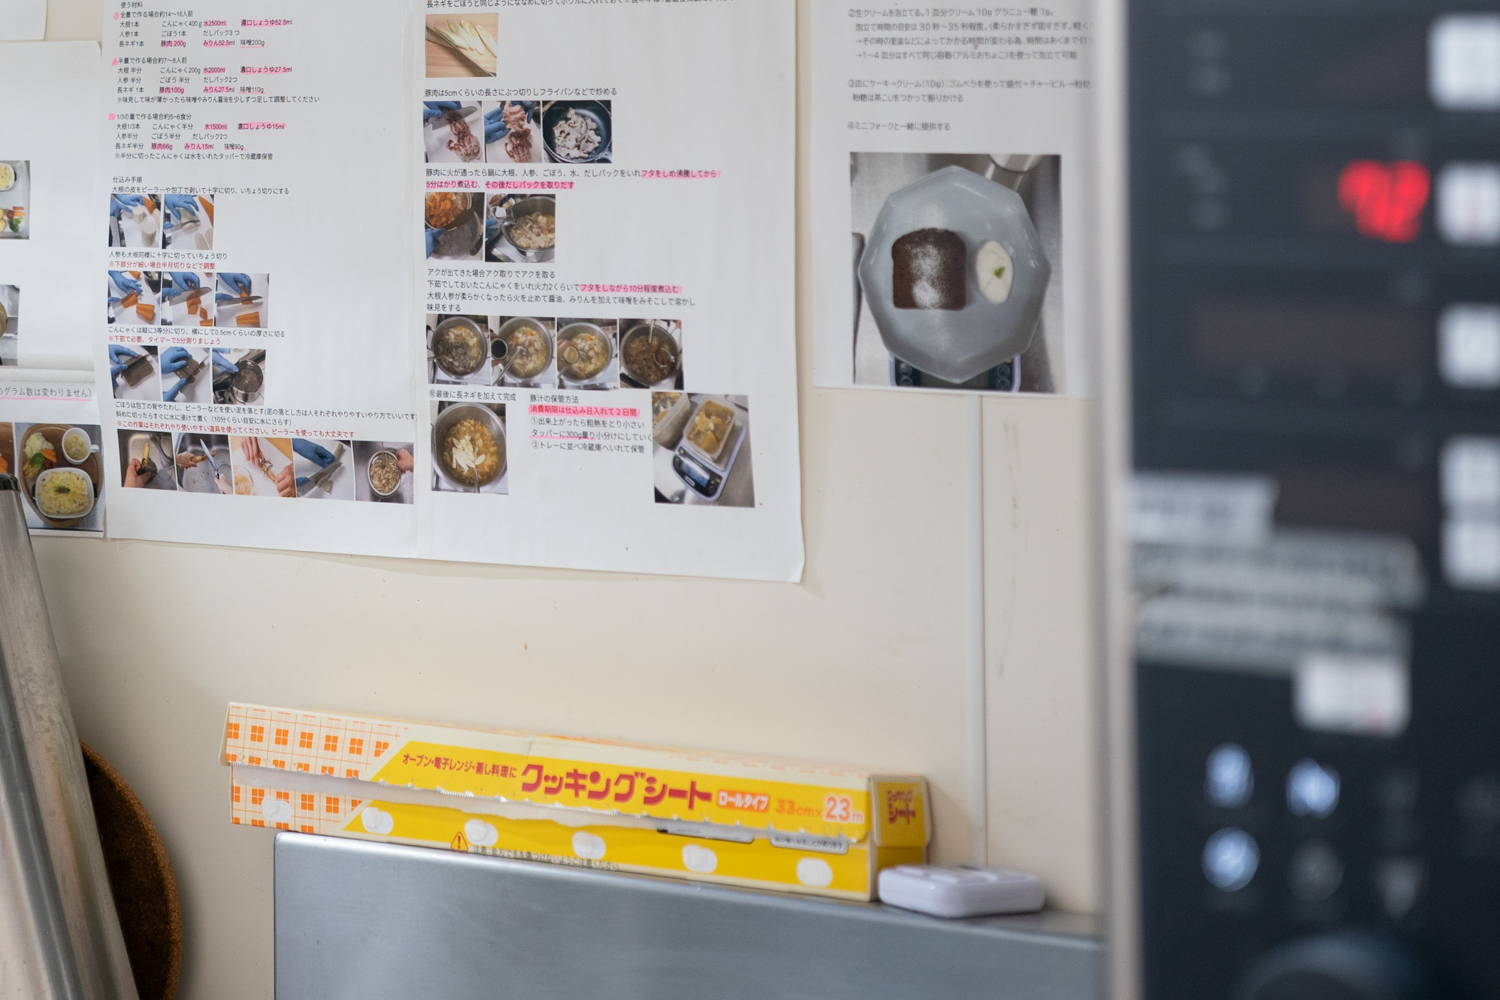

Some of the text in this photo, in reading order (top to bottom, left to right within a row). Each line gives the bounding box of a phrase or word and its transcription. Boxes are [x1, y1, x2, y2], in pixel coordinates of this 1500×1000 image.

[120, 1, 143, 9] 使う材料
[119, 30, 139, 38] 人参1本
[118, 40, 144, 48] 長ネギ1本
[240, 39, 265, 48] 味噌200g
[158, 86, 185, 94] 豚肉100g
[239, 86, 265, 94] 味噌110g
[115, 132, 139, 140] 人参半分
[151, 132, 181, 140] ごぼう半分
[115, 142, 144, 150] 長ネギ半分
[112, 176, 143, 184] 仕込み手順
[427, 268, 556, 279] アクが出てきた場合アク取りでアクを取る
[427, 303, 461, 312] 味見をする
[529, 394, 580, 404] 豚汁の保管方法
[402, 752, 518, 780] オーブン・電子レンジ・蒸し料理に
[521, 762, 713, 811] クッキングシート
[717, 790, 770, 813] ロールタイプ
